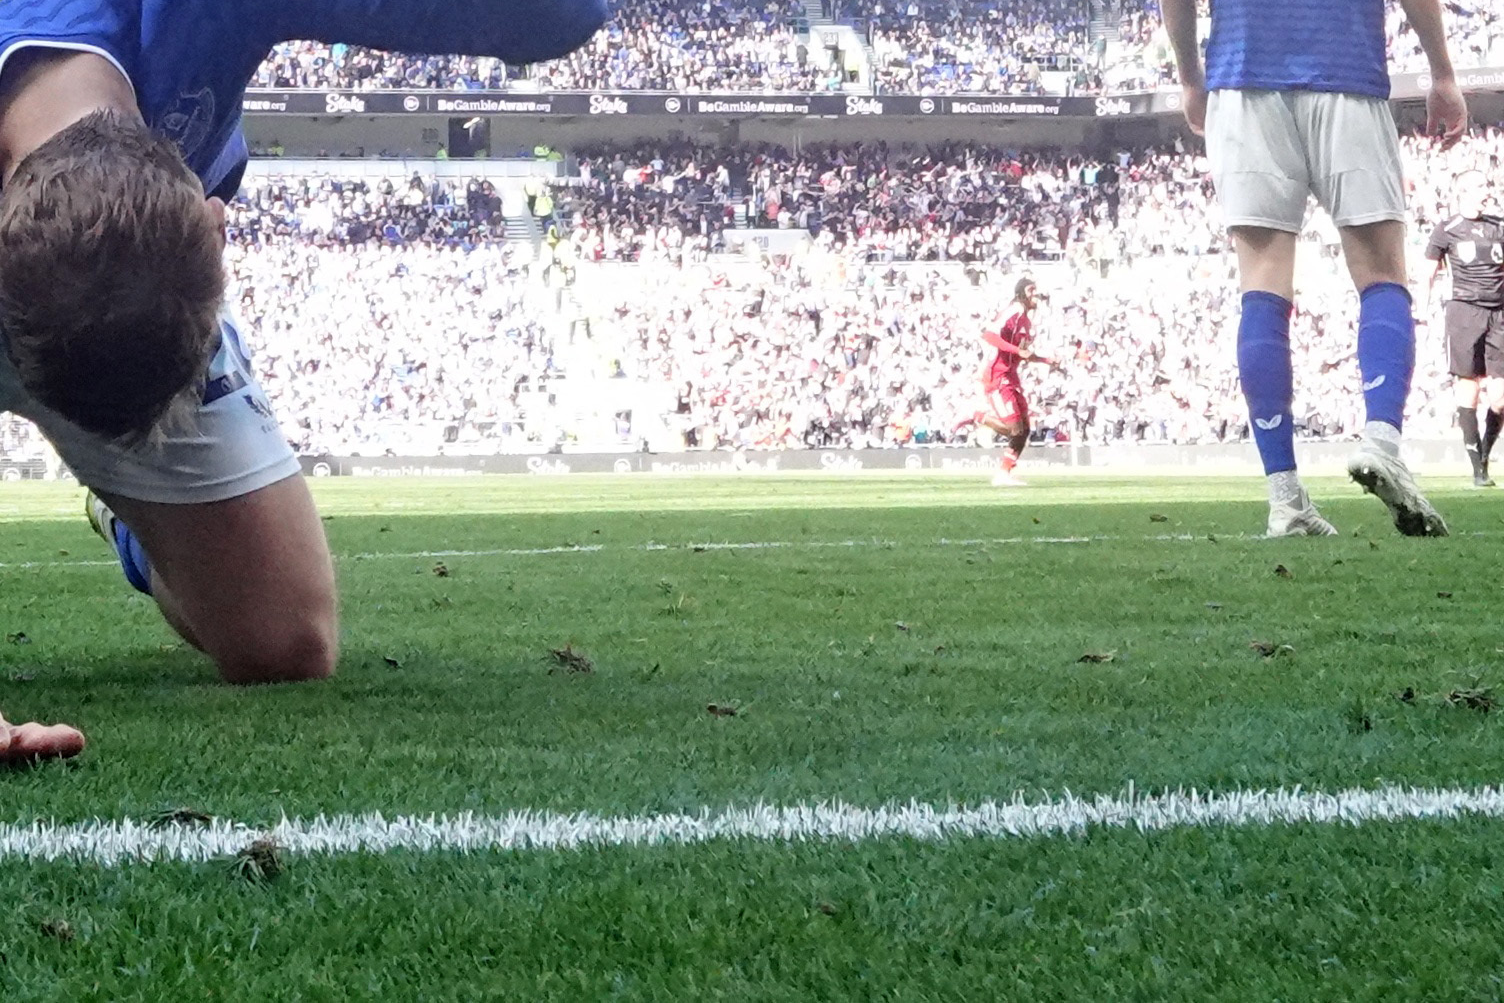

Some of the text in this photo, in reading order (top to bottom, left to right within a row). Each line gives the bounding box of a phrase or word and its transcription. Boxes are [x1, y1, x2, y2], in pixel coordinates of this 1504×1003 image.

[325, 93, 365, 113] Stake
[438, 99, 551, 112] BeGambleAware.org
[589, 95, 628, 115] Stake
[698, 100, 809, 114] BeGambleAware.org
[846, 96, 882, 116] Stake
[951, 101, 1059, 115] BeGambleAware.org
[1094, 96, 1131, 116] Stake
